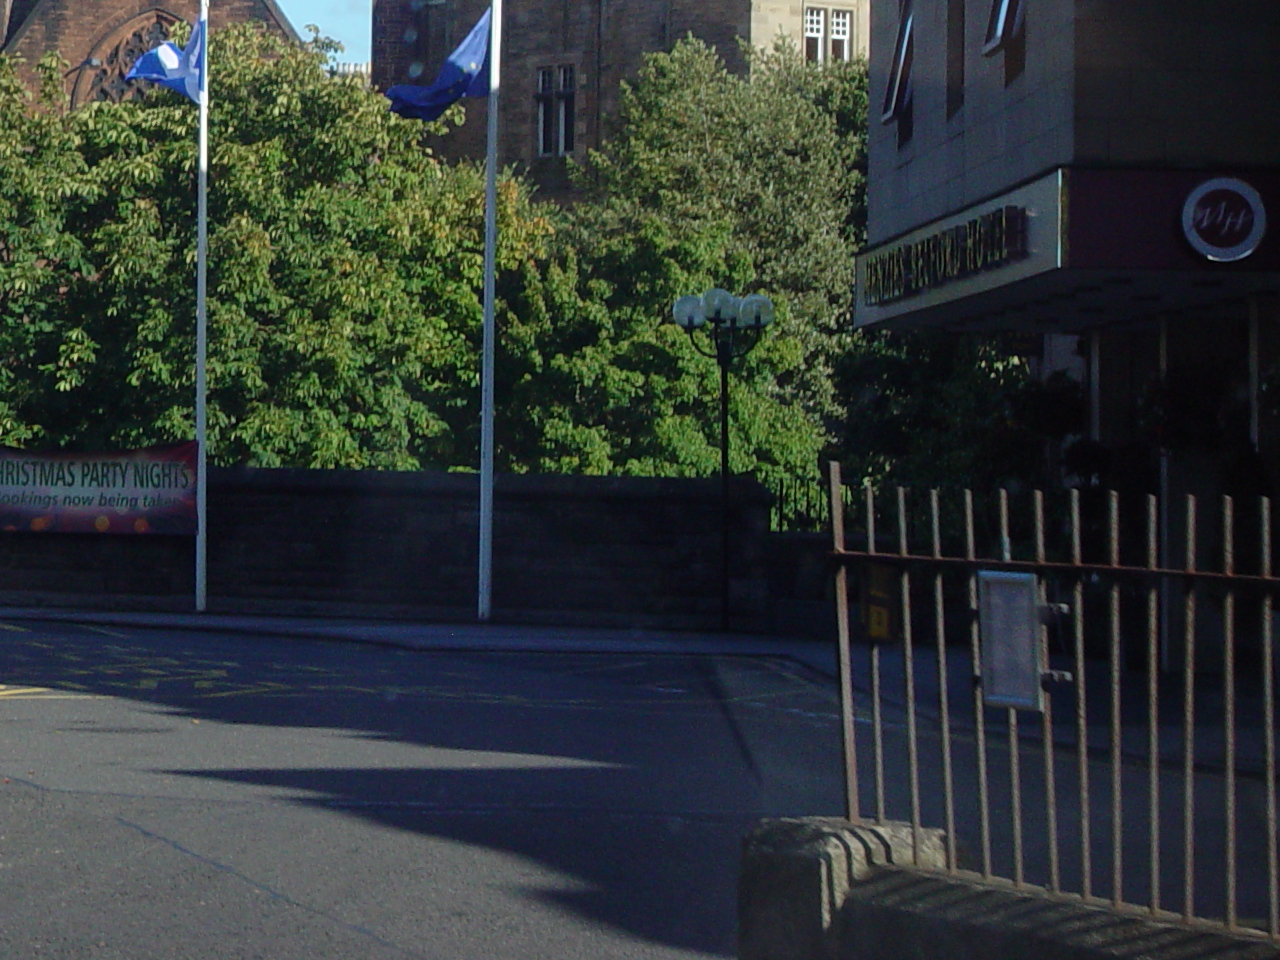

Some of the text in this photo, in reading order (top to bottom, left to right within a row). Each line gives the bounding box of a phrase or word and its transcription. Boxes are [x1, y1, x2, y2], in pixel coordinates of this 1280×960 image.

[80, 461, 129, 487] PARTY
[133, 462, 190, 489] NIGHTS
[62, 496, 94, 506] now
[98, 492, 138, 508] being
